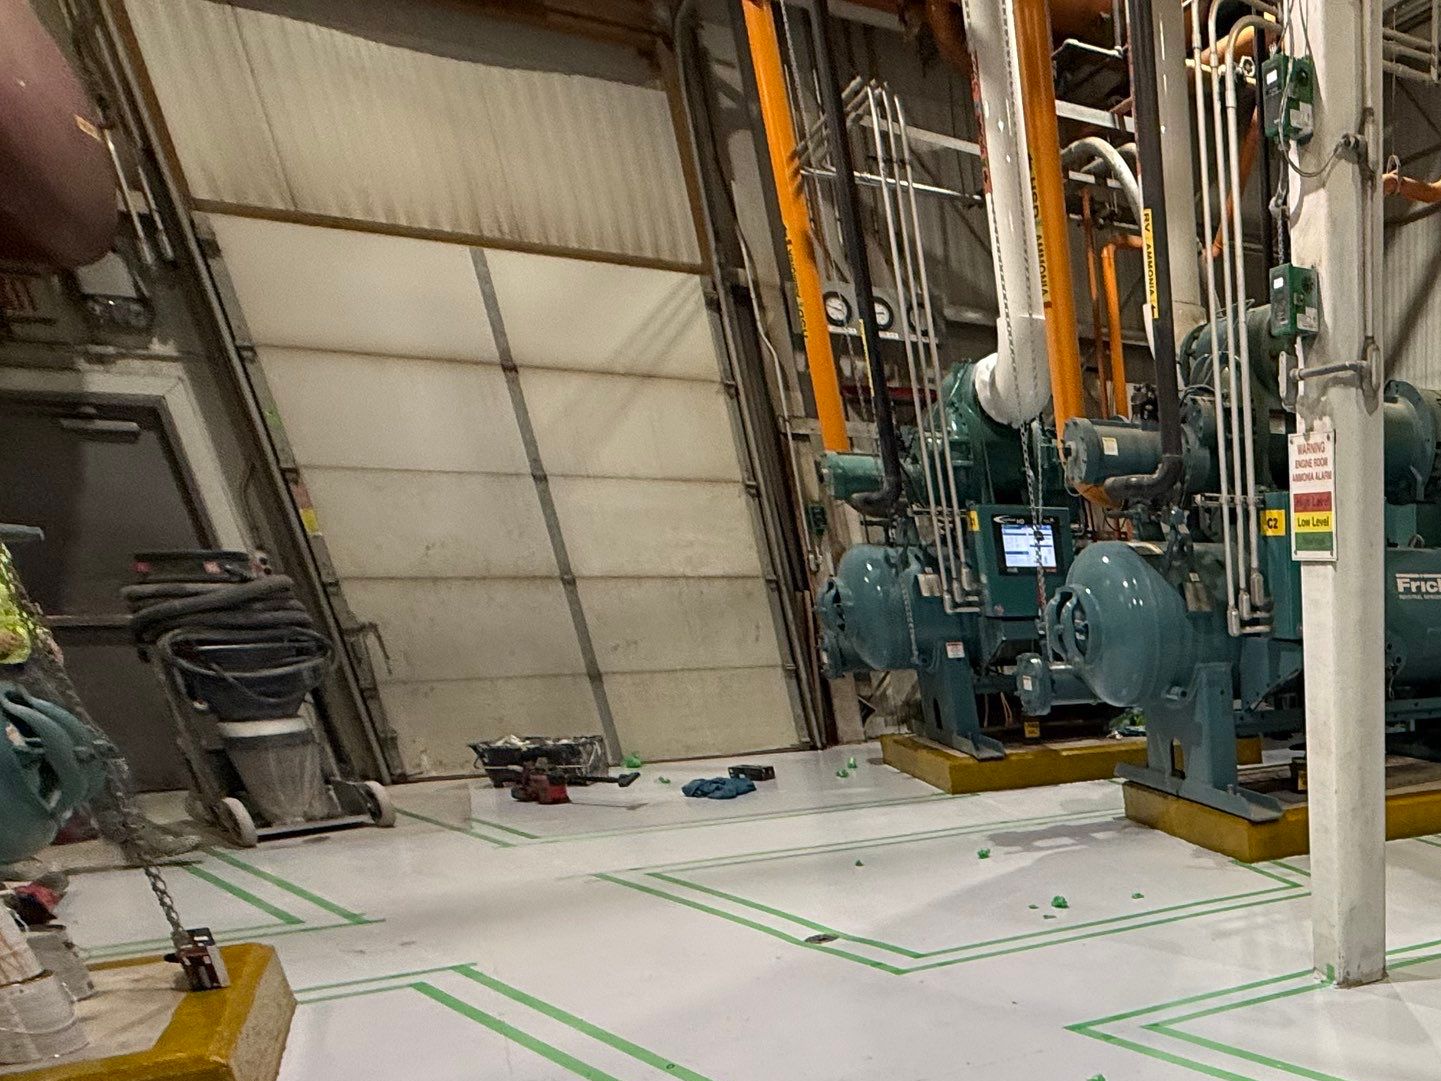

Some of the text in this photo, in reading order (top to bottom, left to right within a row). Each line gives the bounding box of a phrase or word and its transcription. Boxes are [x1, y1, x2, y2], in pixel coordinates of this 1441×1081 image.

[1143, 212, 1155, 296] RV AMMONIA
[1297, 442, 1326, 455] WARNING
[1267, 517, 1279, 529] C2
[1297, 516, 1329, 527] Low Level
